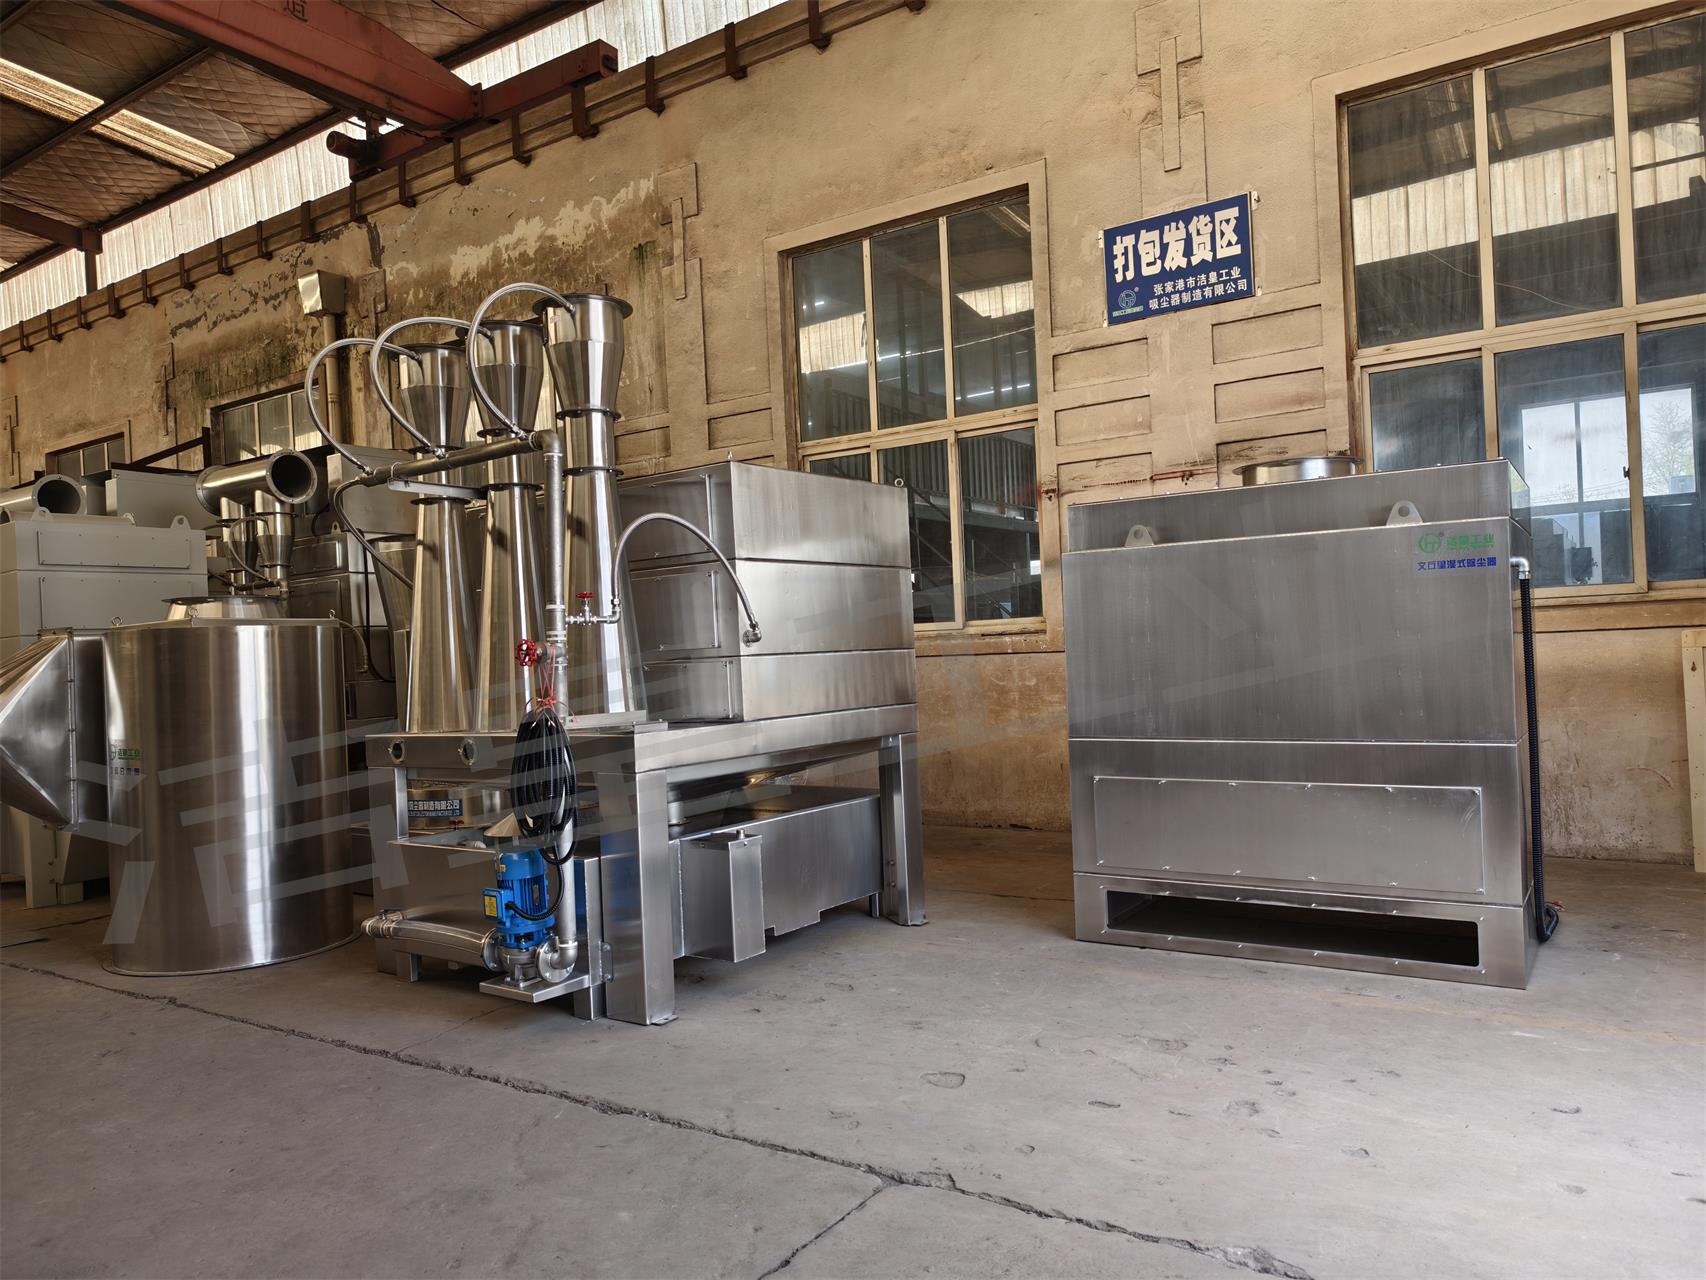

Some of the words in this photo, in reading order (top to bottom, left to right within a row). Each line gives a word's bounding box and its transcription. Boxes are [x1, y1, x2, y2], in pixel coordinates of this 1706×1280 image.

[1113, 206, 1242, 284] 打包发货区
[1148, 279, 1248, 311] 吸尘器制造有限公司
[1153, 266, 1242, 297] 张家港市洁皇工业
